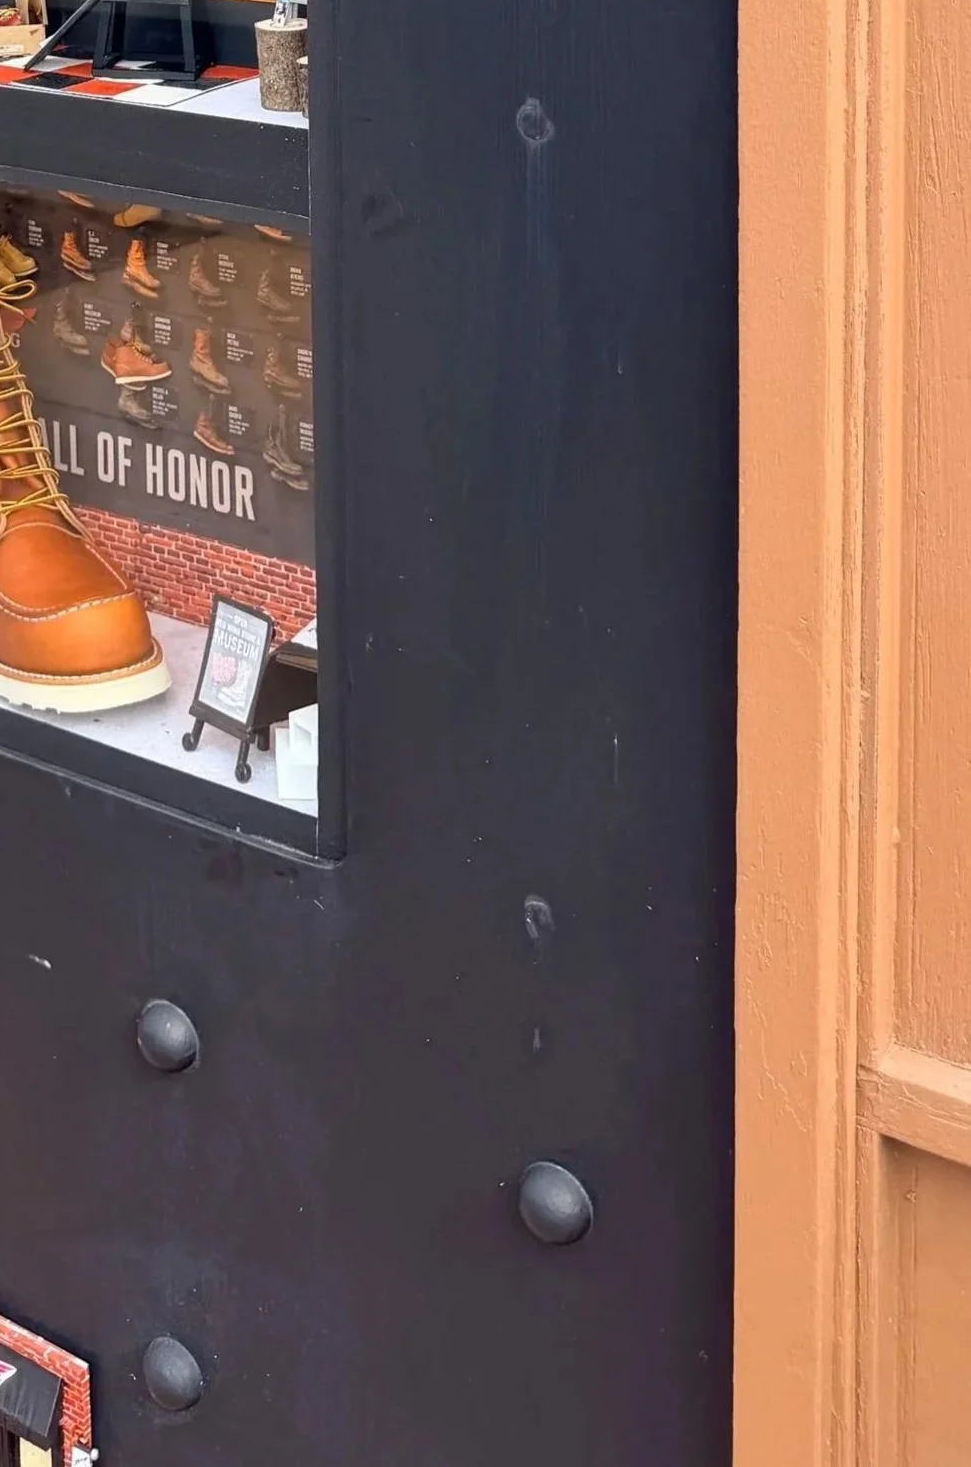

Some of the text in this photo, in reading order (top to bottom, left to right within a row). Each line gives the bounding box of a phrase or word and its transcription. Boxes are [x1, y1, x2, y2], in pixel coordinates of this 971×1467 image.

[97, 431, 132, 487] OF
[145, 443, 256, 521] HONOR
[214, 628, 262, 662] MUSEUM
